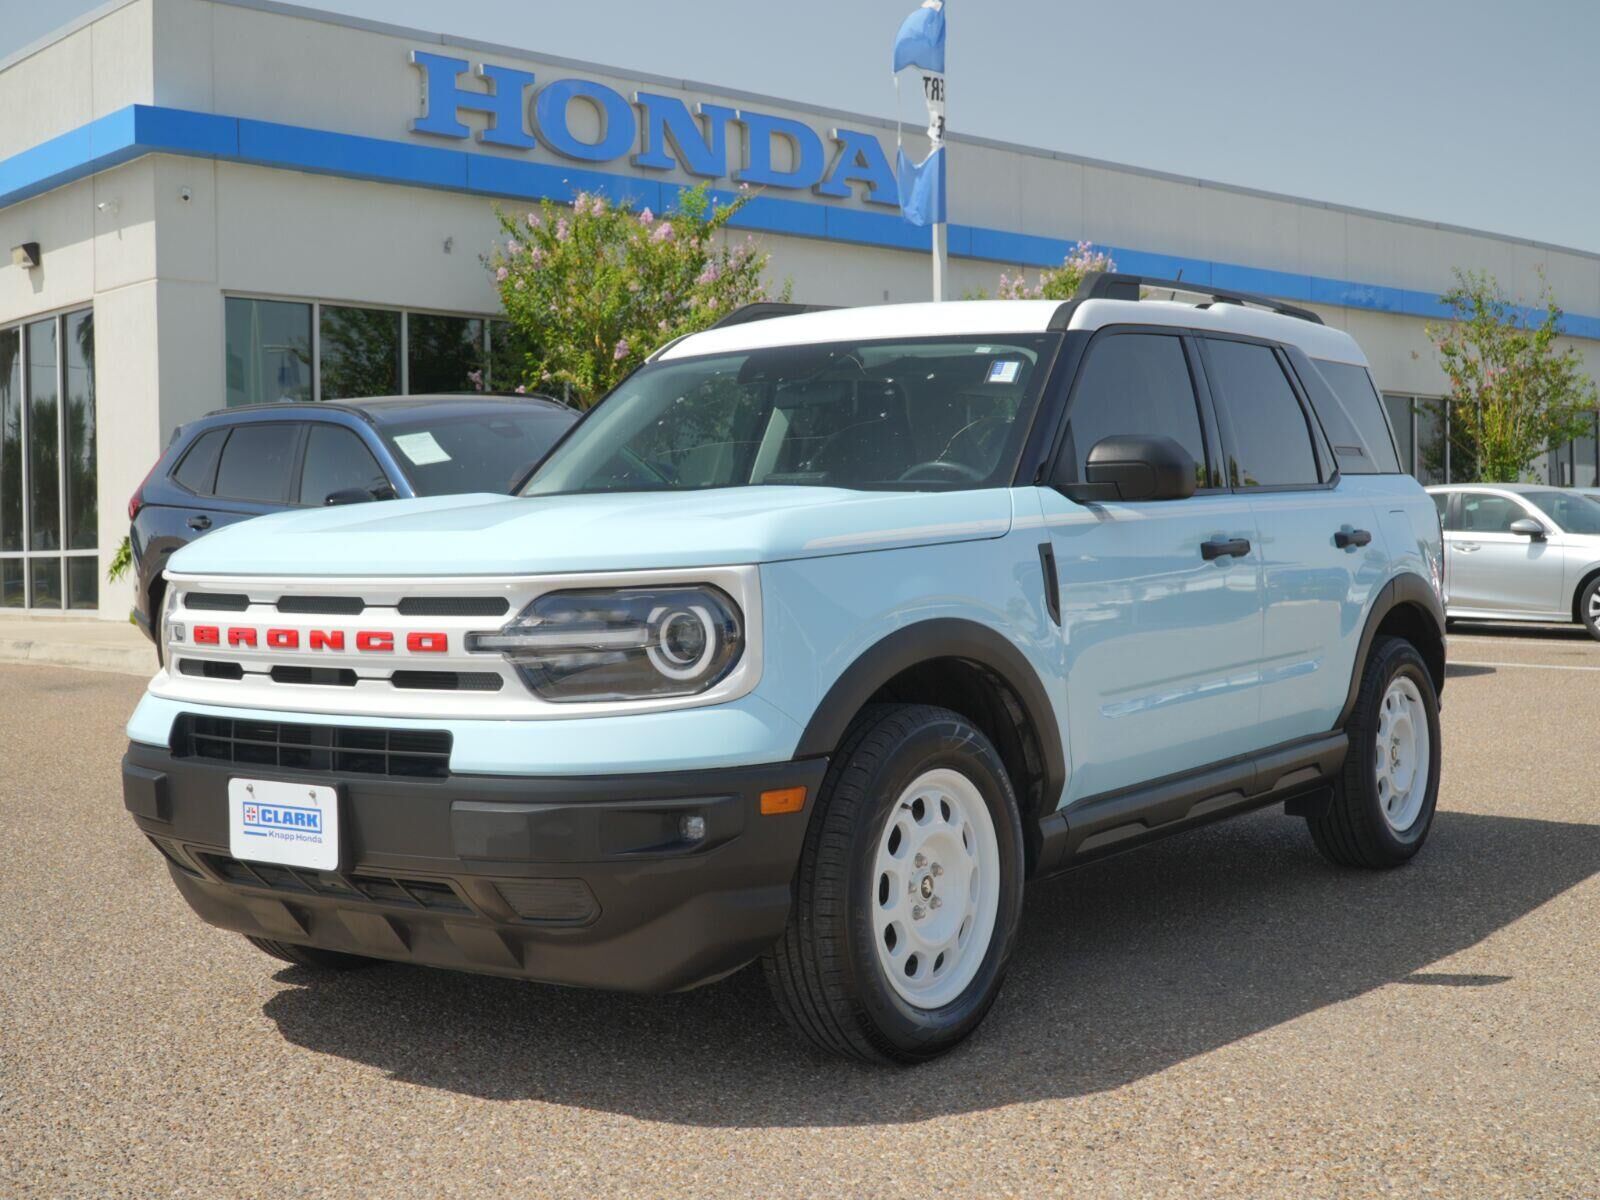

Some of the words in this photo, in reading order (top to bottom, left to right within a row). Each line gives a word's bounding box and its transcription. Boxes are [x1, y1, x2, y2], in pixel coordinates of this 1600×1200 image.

[408, 50, 900, 206] HONDA
[193, 625, 449, 653] BRONCO
[261, 809, 318, 827] CLARK
[268, 831, 295, 841] Knapp
[296, 834, 322, 843] Honda
